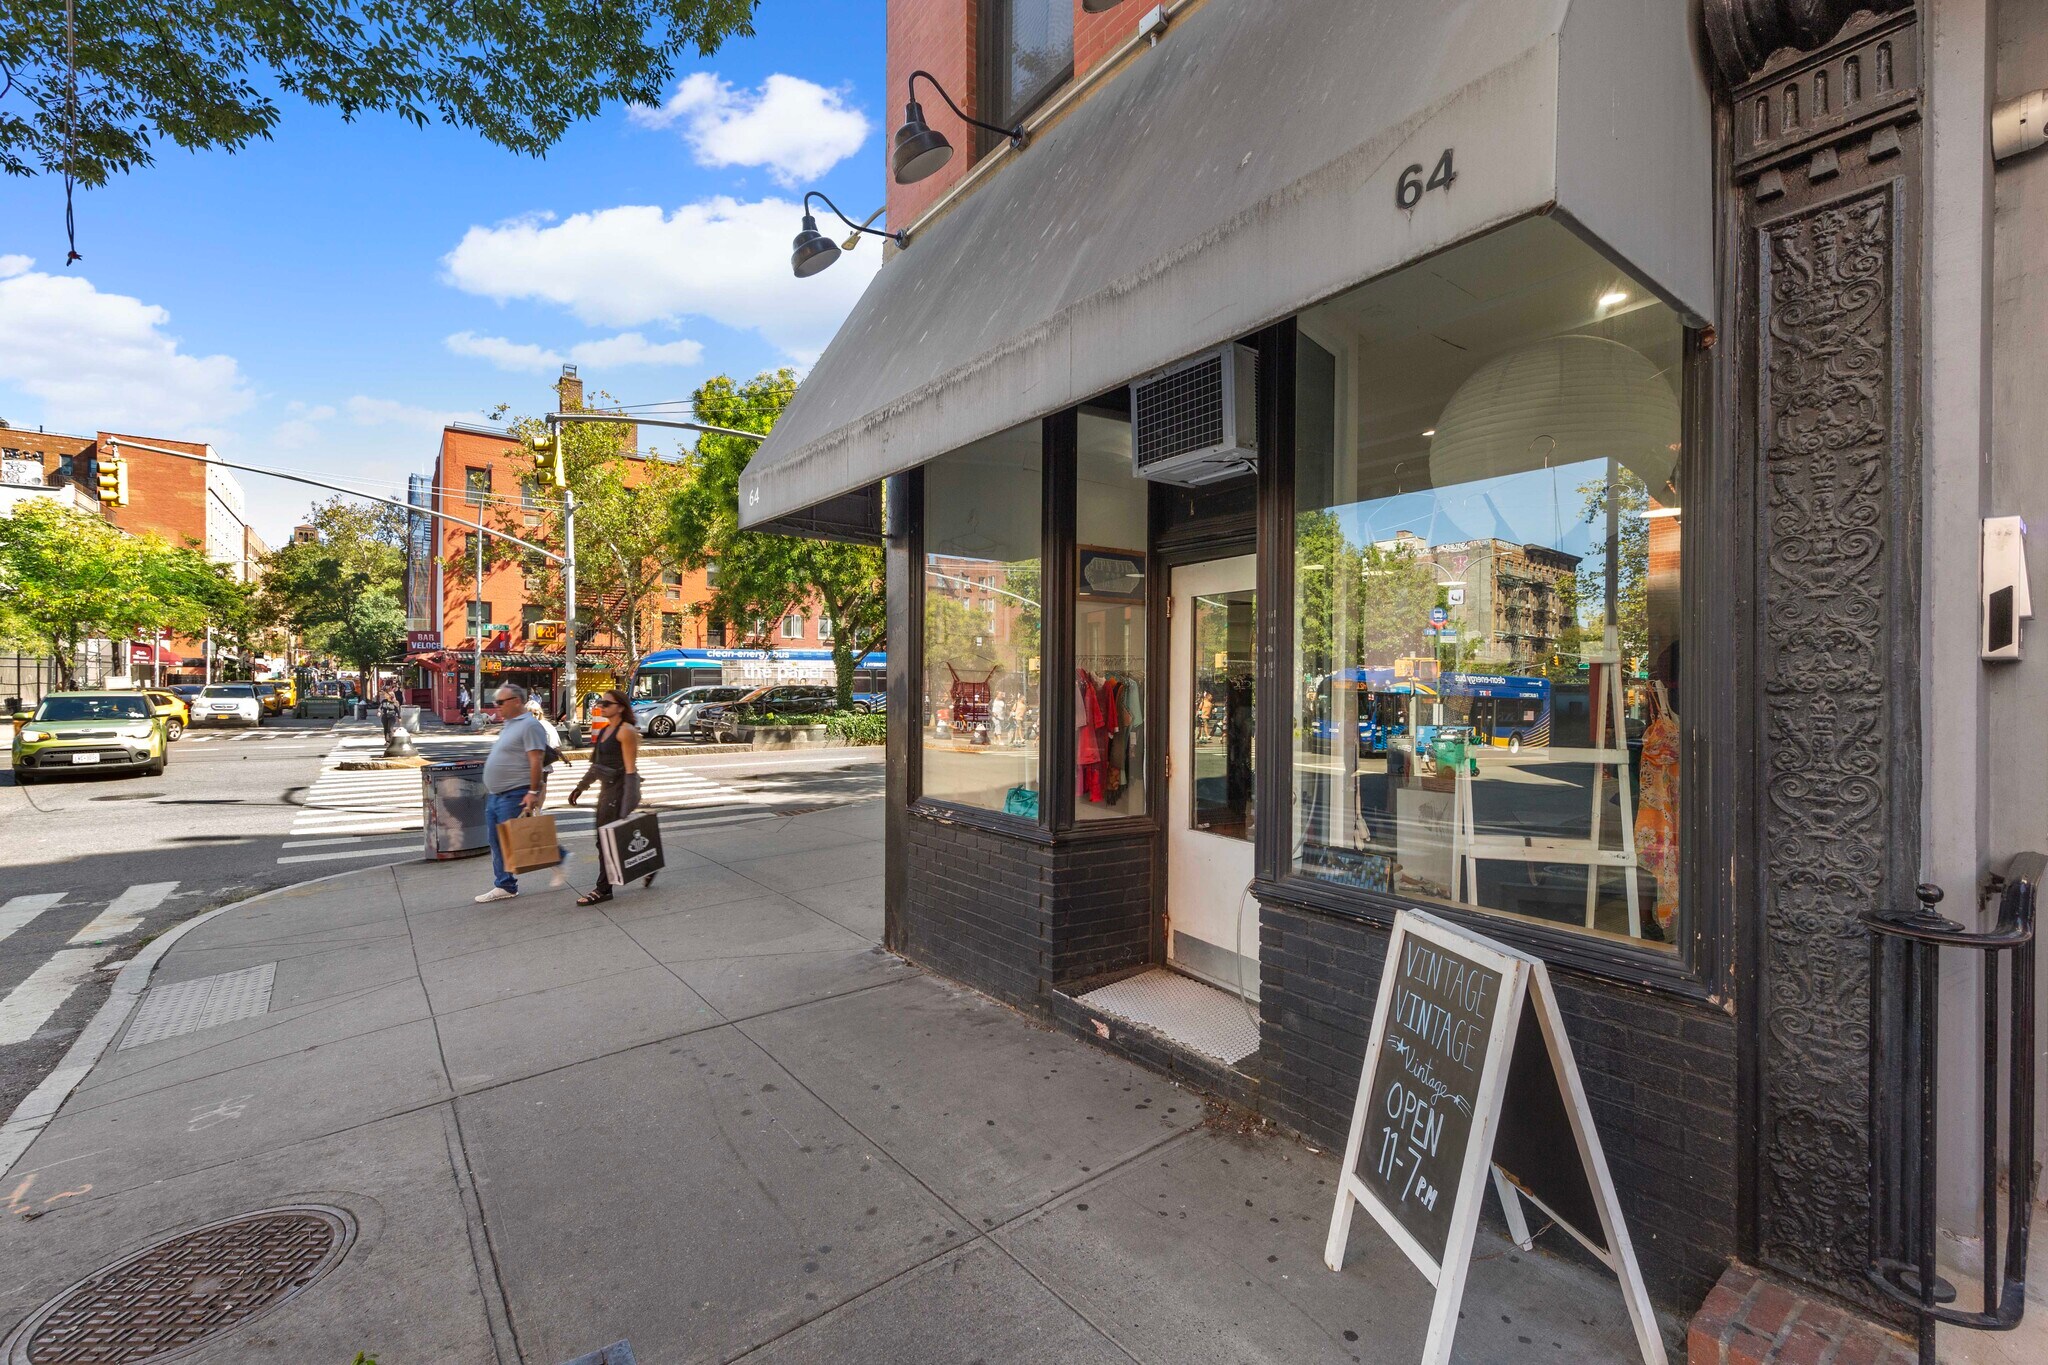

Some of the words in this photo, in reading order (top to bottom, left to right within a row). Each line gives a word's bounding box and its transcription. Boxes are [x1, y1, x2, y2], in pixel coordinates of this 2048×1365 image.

[1395, 148, 1457, 210] 64
[749, 487, 759, 506] 64
[417, 633, 435, 641] BAR
[545, 626, 556, 638] 22
[411, 641, 441, 650] VELOCE
[706, 650, 771, 660] clean-energy
[772, 650, 790, 659] bus
[743, 662, 772, 679] the
[777, 667, 823, 682] paper
[1407, 941, 1494, 1020] VINTAGE
[1396, 985, 1482, 1072] VINTAGE
[1403, 1045, 1450, 1106] Vintage
[1387, 1082, 1444, 1157] OPEN
[1378, 1126, 1422, 1201] 11-7
[96, 1276, 194, 1292] SEWER
